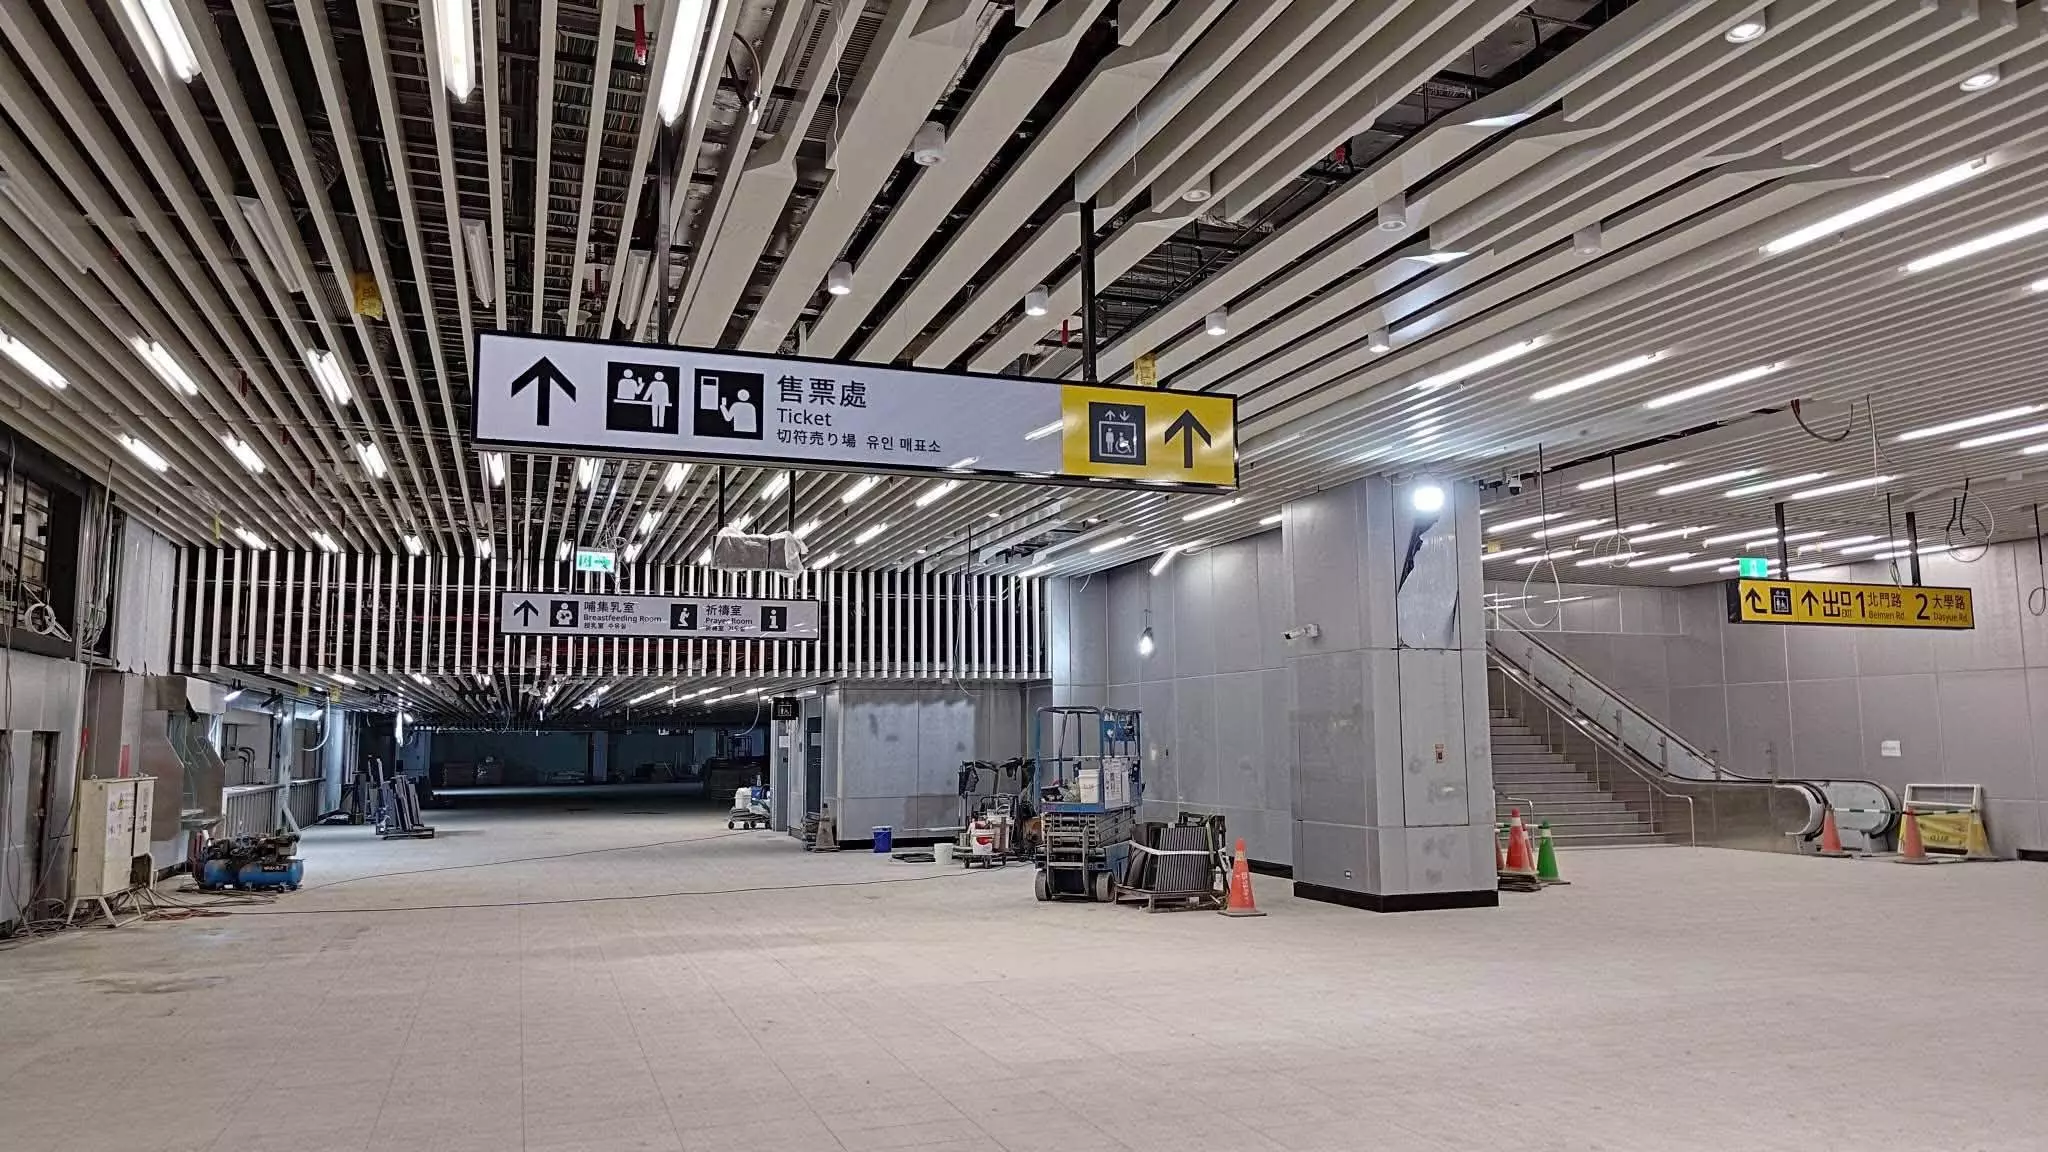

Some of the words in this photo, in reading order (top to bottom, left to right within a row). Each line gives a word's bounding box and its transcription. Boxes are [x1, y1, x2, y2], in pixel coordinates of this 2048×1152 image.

[777, 375, 867, 408] 售票處
[777, 408, 832, 426] Ticket
[777, 429, 856, 448] 切符売り場
[866, 435, 894, 451] 유인
[900, 438, 941, 452] 매표소
[583, 601, 635, 613] 哺集乳室
[1823, 590, 1852, 617] 出口
[1856, 591, 1866, 618] 1
[1867, 592, 1902, 608] 北門路
[1915, 593, 1931, 620] 2
[1932, 595, 1965, 610] 大學路
[584, 614, 638, 623] Breastfeeding
[640, 615, 662, 623] Room
[705, 617, 730, 625] Prayer
